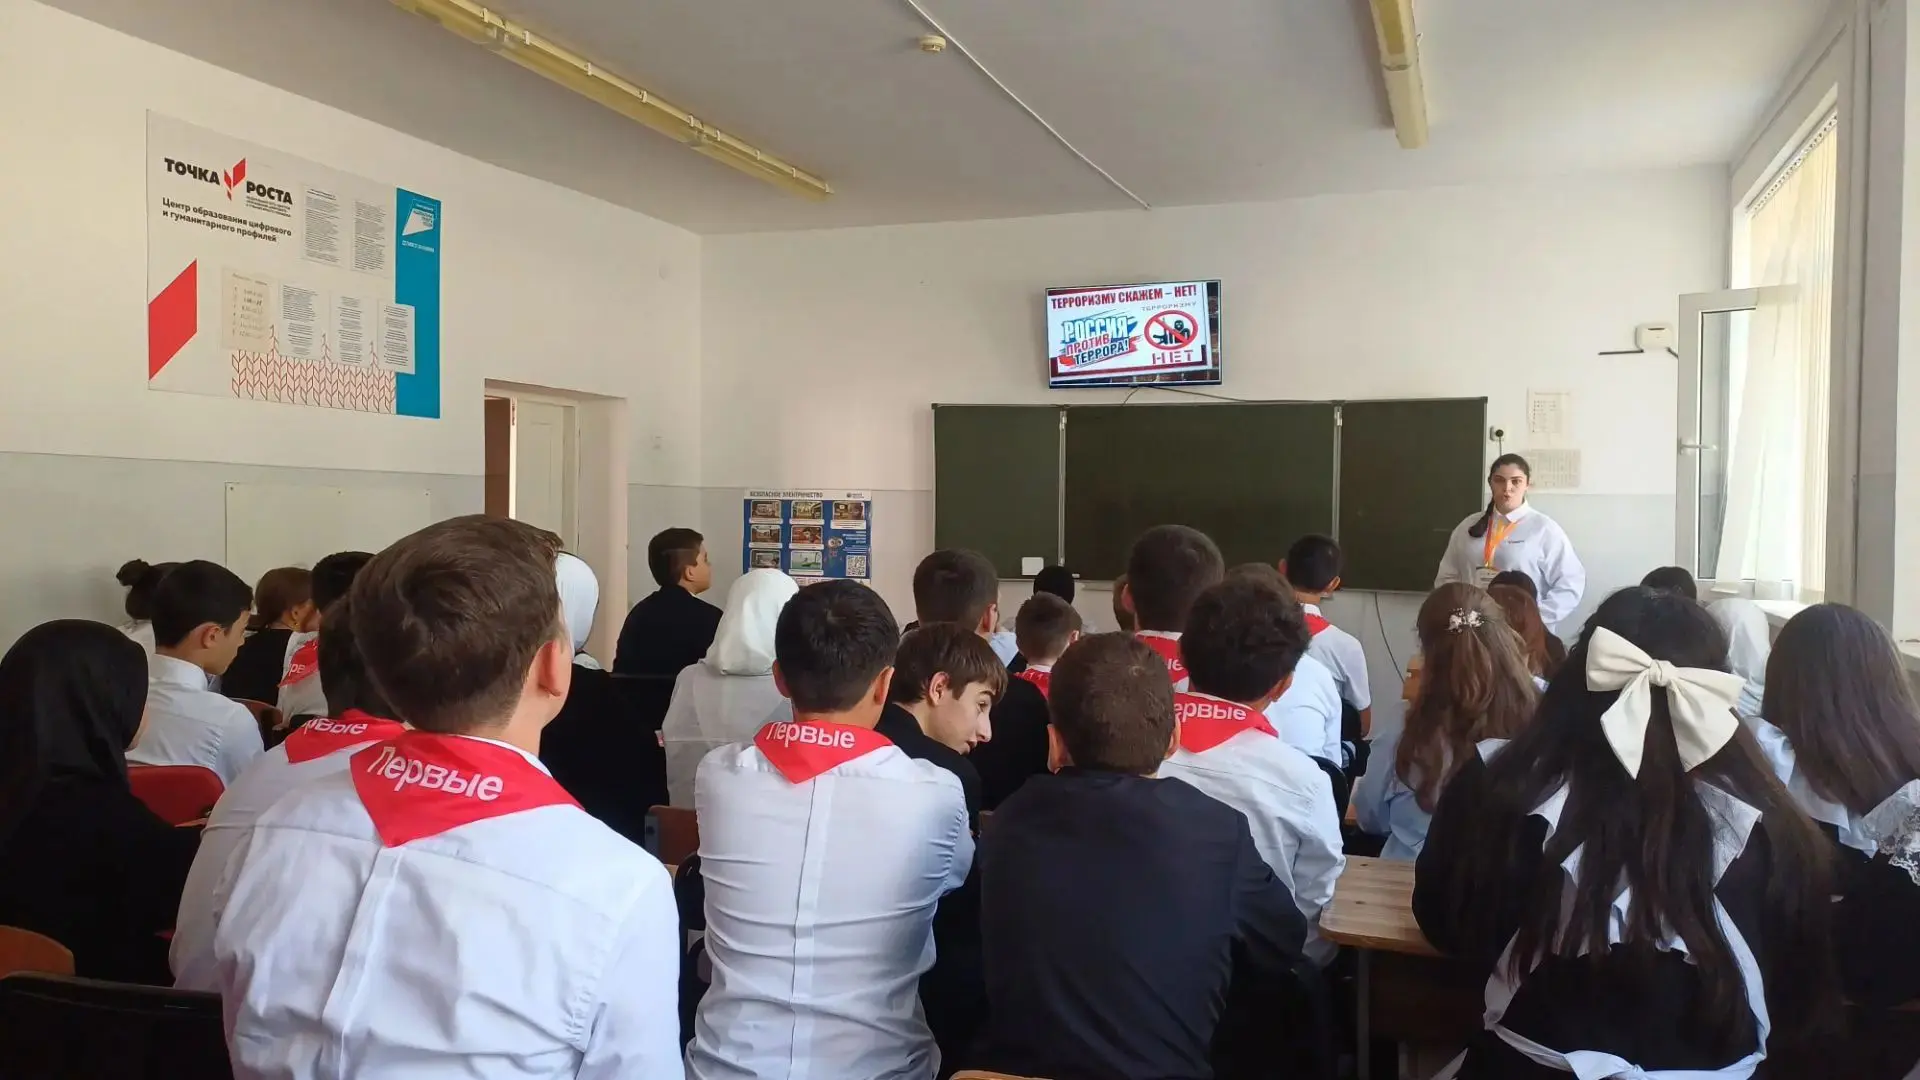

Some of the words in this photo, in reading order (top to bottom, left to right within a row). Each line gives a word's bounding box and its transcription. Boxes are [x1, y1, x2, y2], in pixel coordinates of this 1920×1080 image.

[164, 157, 220, 186] ТОЧКА
[246, 180, 293, 205] РОСТА
[162, 197, 191, 213] Центр
[192, 205, 248, 225] образования
[248, 219, 292, 237] цифрового
[170, 210, 235, 233] гуманитарного
[236, 226, 277, 243] профилей
[1051, 292, 1117, 310] ТЕРРОРИЗМУ
[1118, 287, 1163, 303] СКАЖЕМ
[1174, 284, 1197, 298] НЕТ!
[1063, 316, 1130, 344] РОССИЯ
[1065, 333, 1112, 356] ПРОТИВ
[1074, 338, 1130, 366] ТЕРРОРА!
[1152, 349, 1194, 365] НЕТ
[1173, 701, 1247, 722] ервые
[766, 721, 856, 749] Первые
[367, 745, 504, 801] Первые
